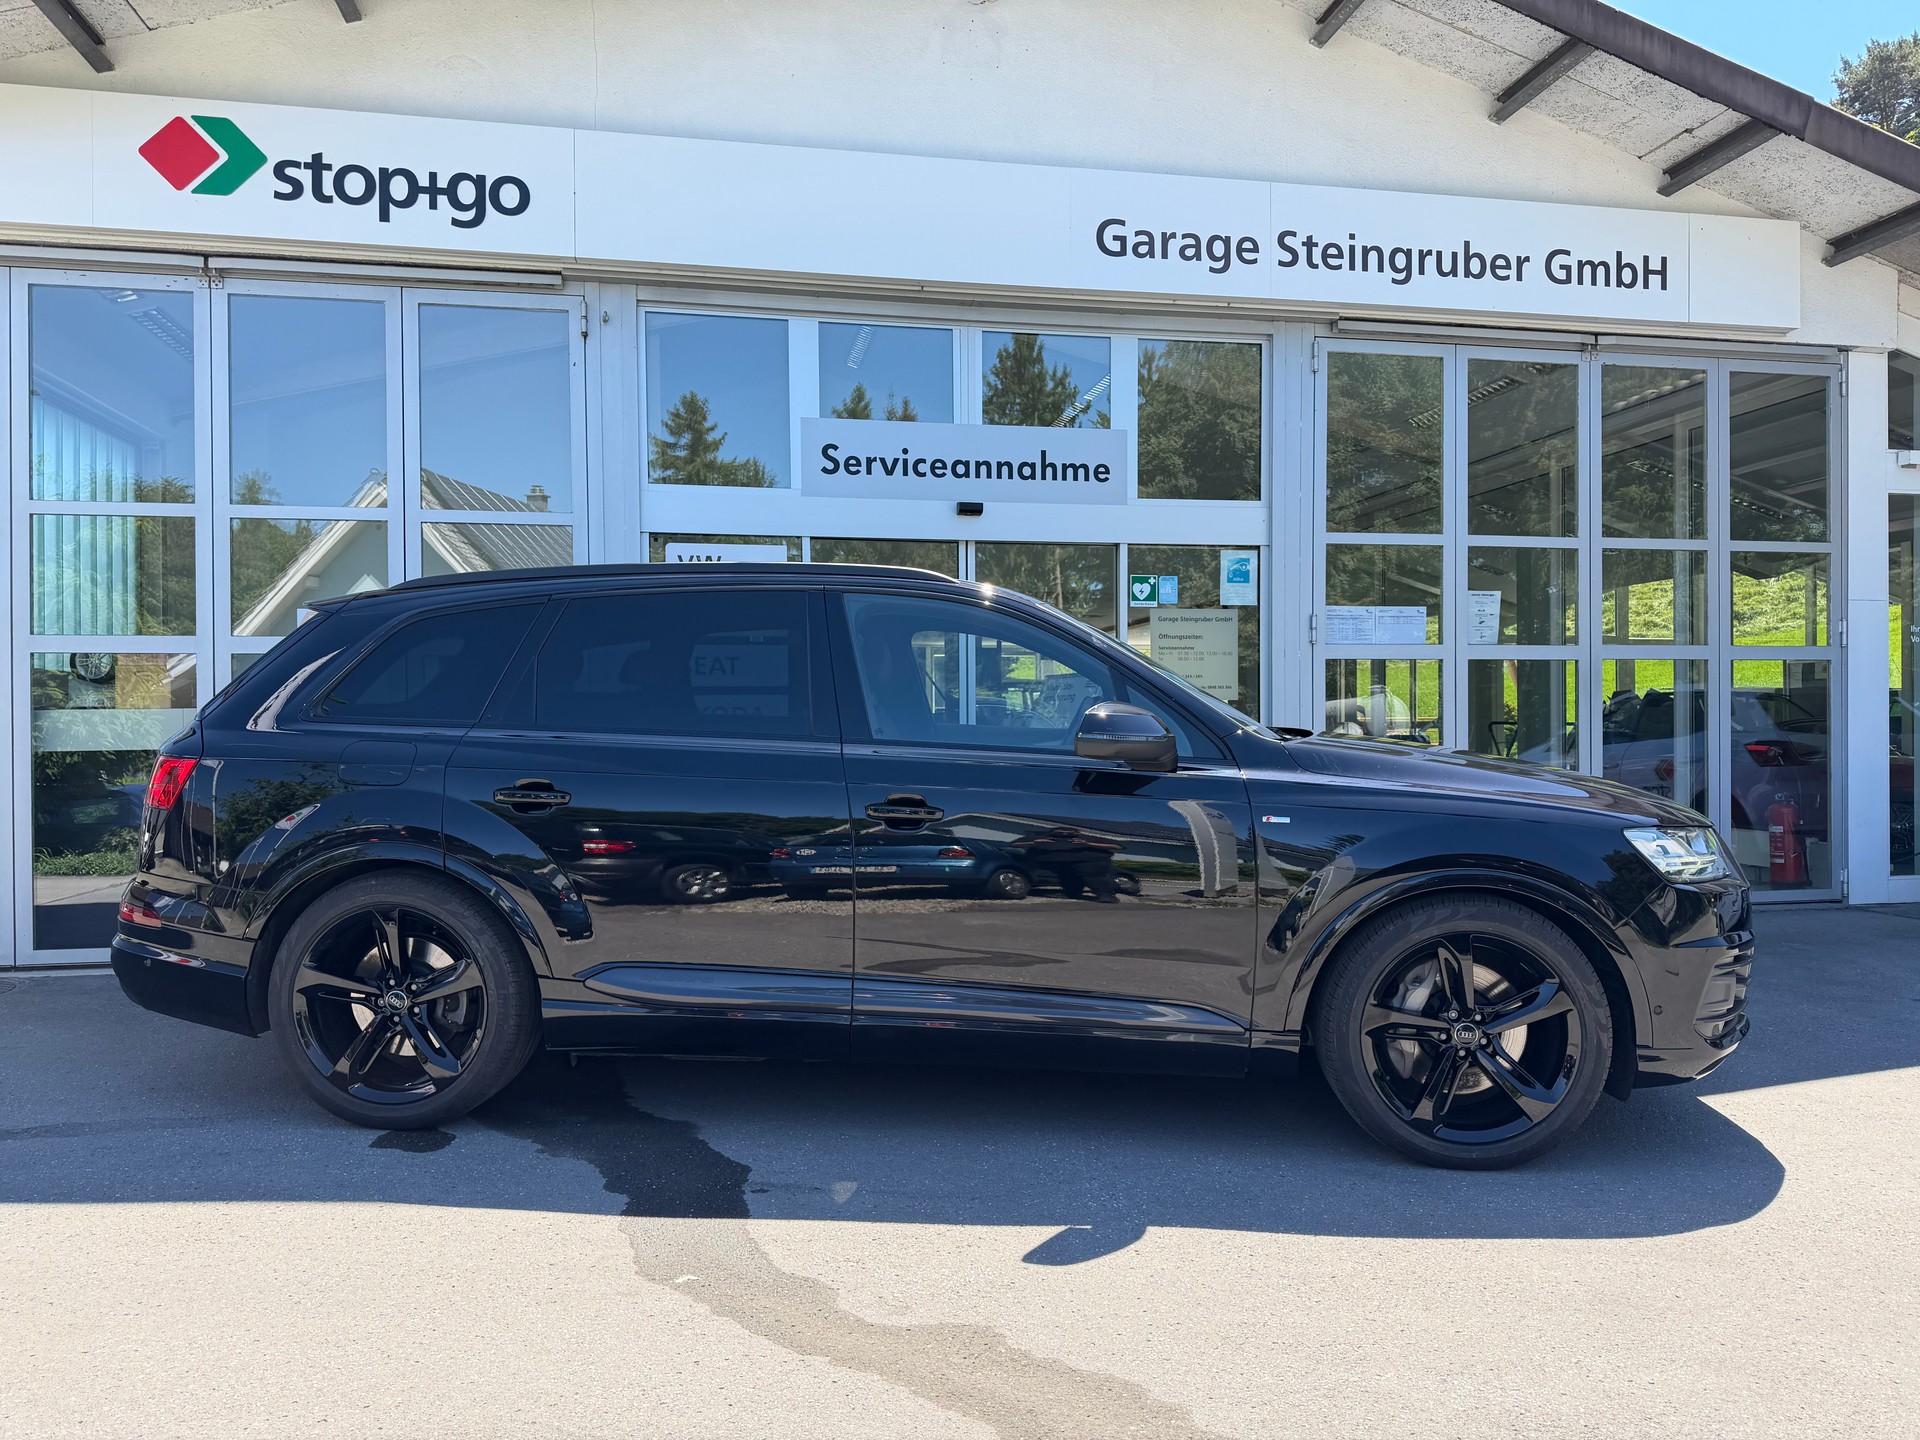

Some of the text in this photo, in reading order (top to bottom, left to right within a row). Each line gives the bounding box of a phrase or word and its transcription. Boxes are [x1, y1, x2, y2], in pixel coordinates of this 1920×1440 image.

[272, 152, 531, 229] stop+go
[1095, 218, 1668, 291] Garage Steingruber GmbH
[820, 443, 1111, 483] Serviceannahme
[1157, 616, 1179, 624] Garage
[1180, 616, 1214, 624] Steingruber
[1158, 633, 1204, 641] Öffnungszeiten:
[694, 656, 740, 675] EAT
